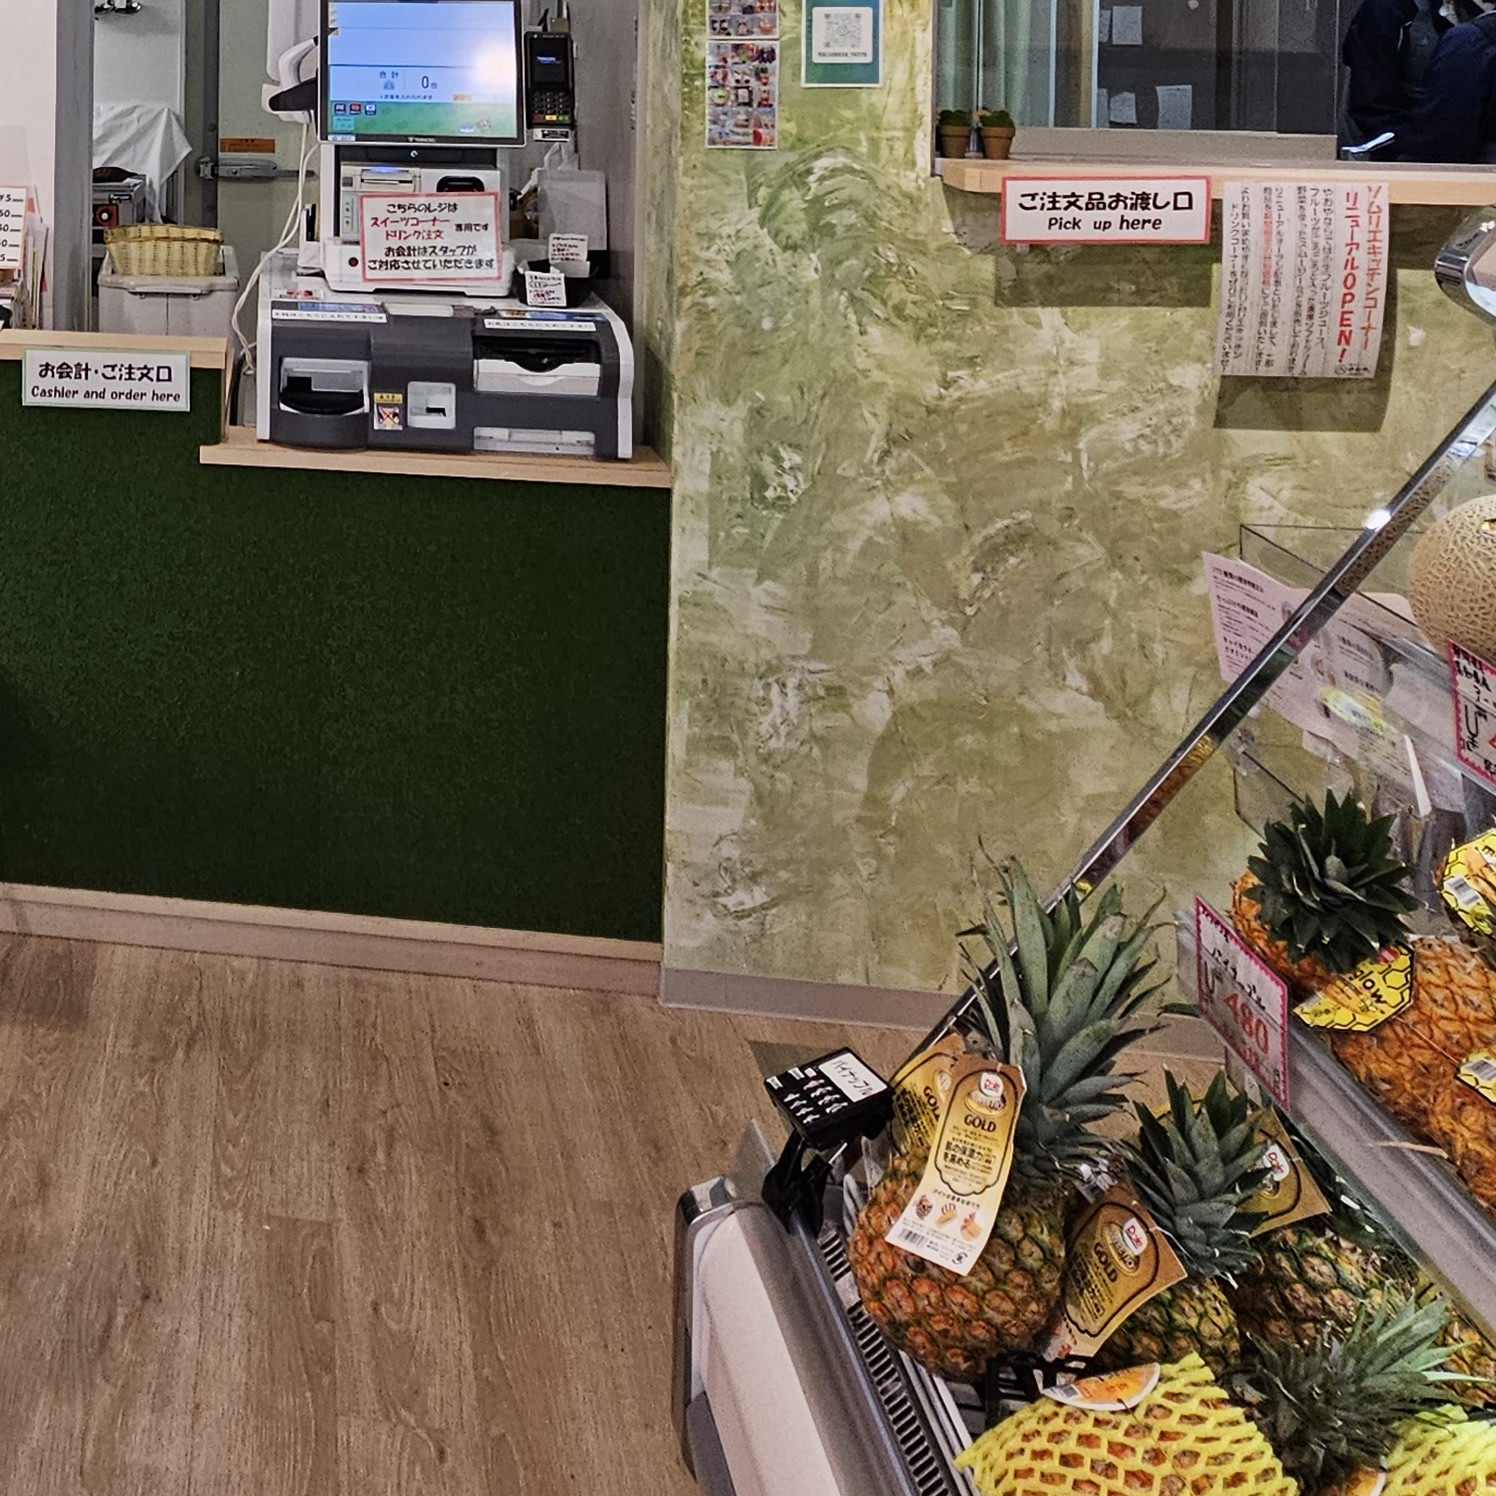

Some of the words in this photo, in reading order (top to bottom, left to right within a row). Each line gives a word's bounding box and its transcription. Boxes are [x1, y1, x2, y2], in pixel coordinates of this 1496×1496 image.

[386, 202, 458, 213] こちらのレジは
[1018, 191, 1194, 211] ご注文品お渡し口
[370, 216, 450, 227] スイーツコーナー
[455, 223, 489, 232] 専用です
[1047, 217, 1082, 230] Pick
[1093, 220, 1112, 231] up
[1119, 215, 1162, 230] here
[385, 229, 444, 240] ドリンク注文
[384, 245, 477, 257] お会計はスタッフが
[367, 258, 495, 270] ご対応させていただきます
[1360, 185, 1383, 350] ソムリエキッチンコーナー
[1336, 192, 1361, 363] リニューアルOPEN!
[38, 362, 173, 382] お会計・ご注文口
[31, 385, 78, 399] Cashier
[84, 387, 106, 399] and
[111, 388, 147, 401] order
[151, 390, 181, 402] here
[964, 1114, 997, 1133] GOLD
[1094, 1242, 1119, 1283] GOLD
